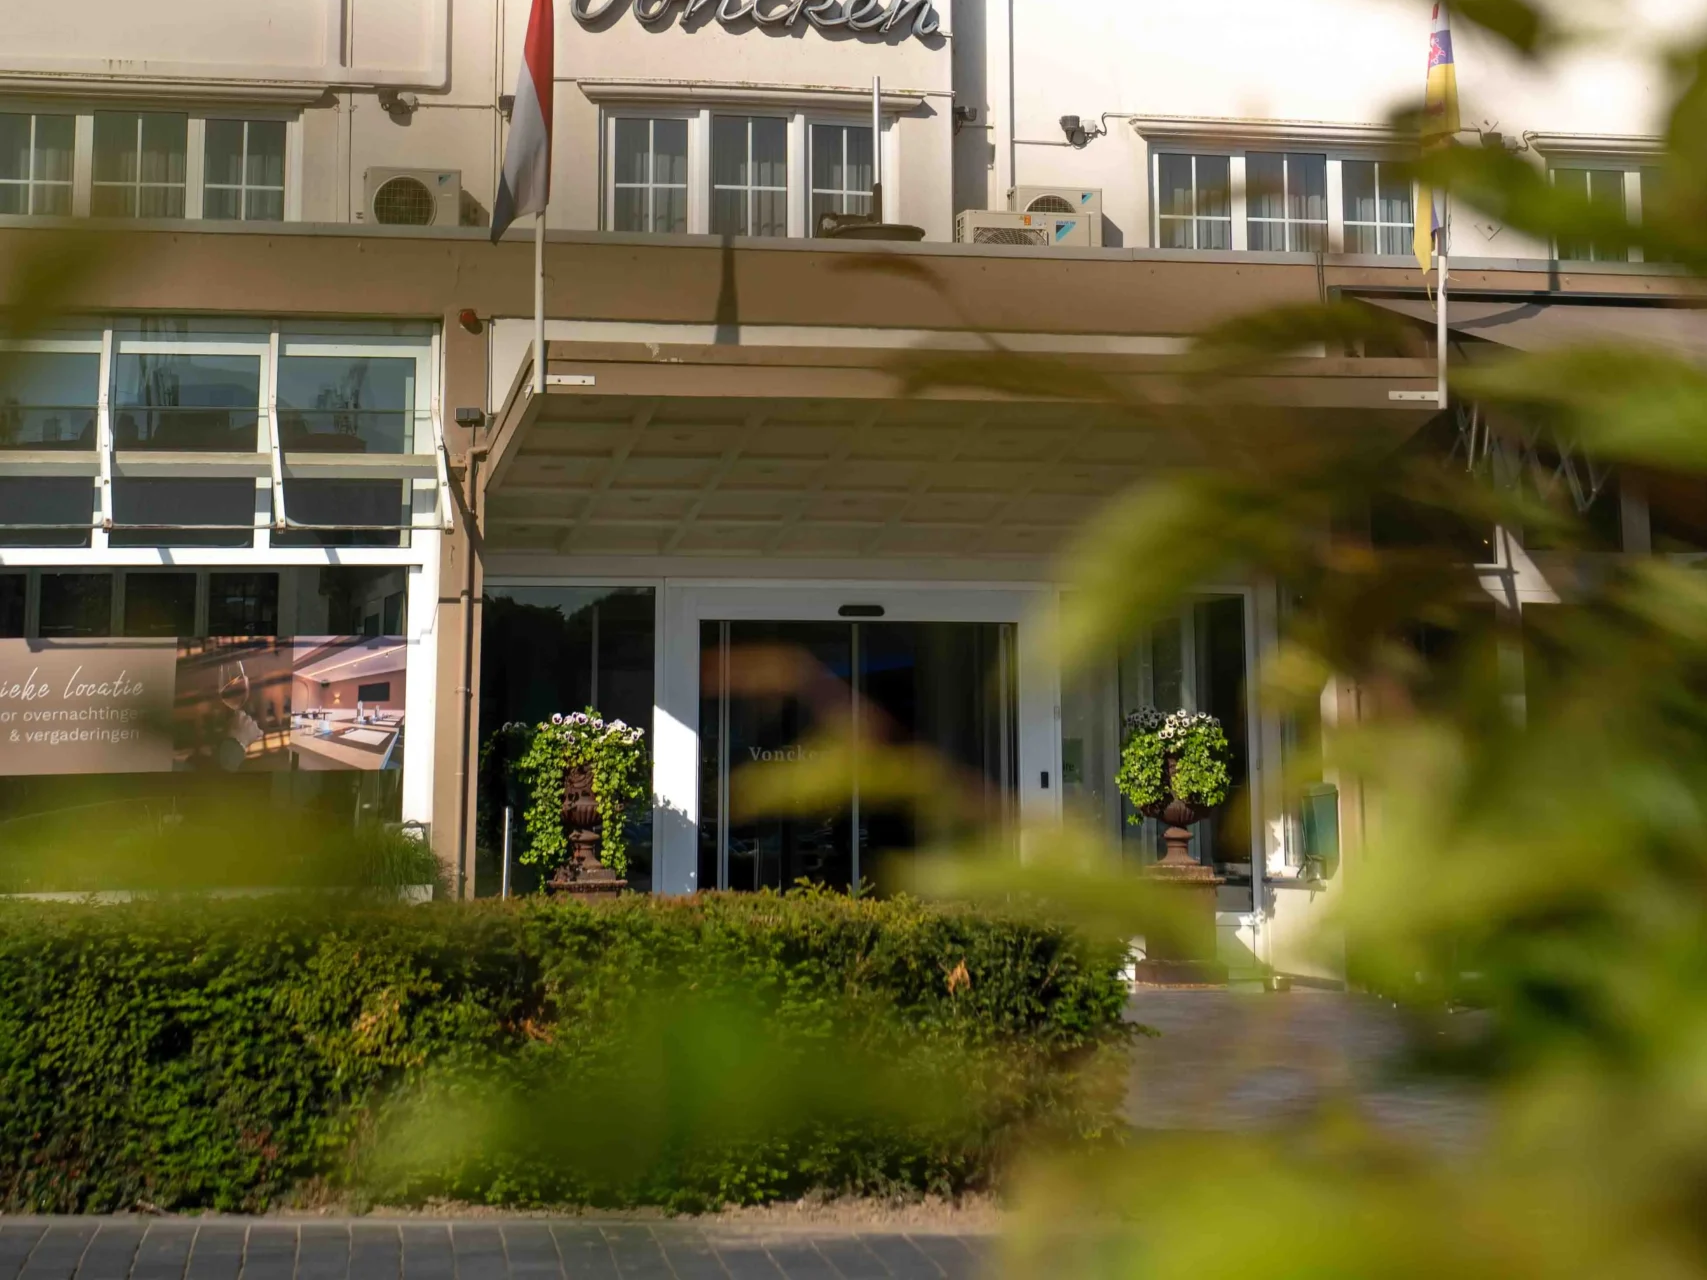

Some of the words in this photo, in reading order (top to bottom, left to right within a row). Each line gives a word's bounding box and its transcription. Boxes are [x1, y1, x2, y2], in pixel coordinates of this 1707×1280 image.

[23, 706, 142, 723] overnachtinge
[9, 728, 20, 742] &
[25, 728, 140, 745] vergaderingen
